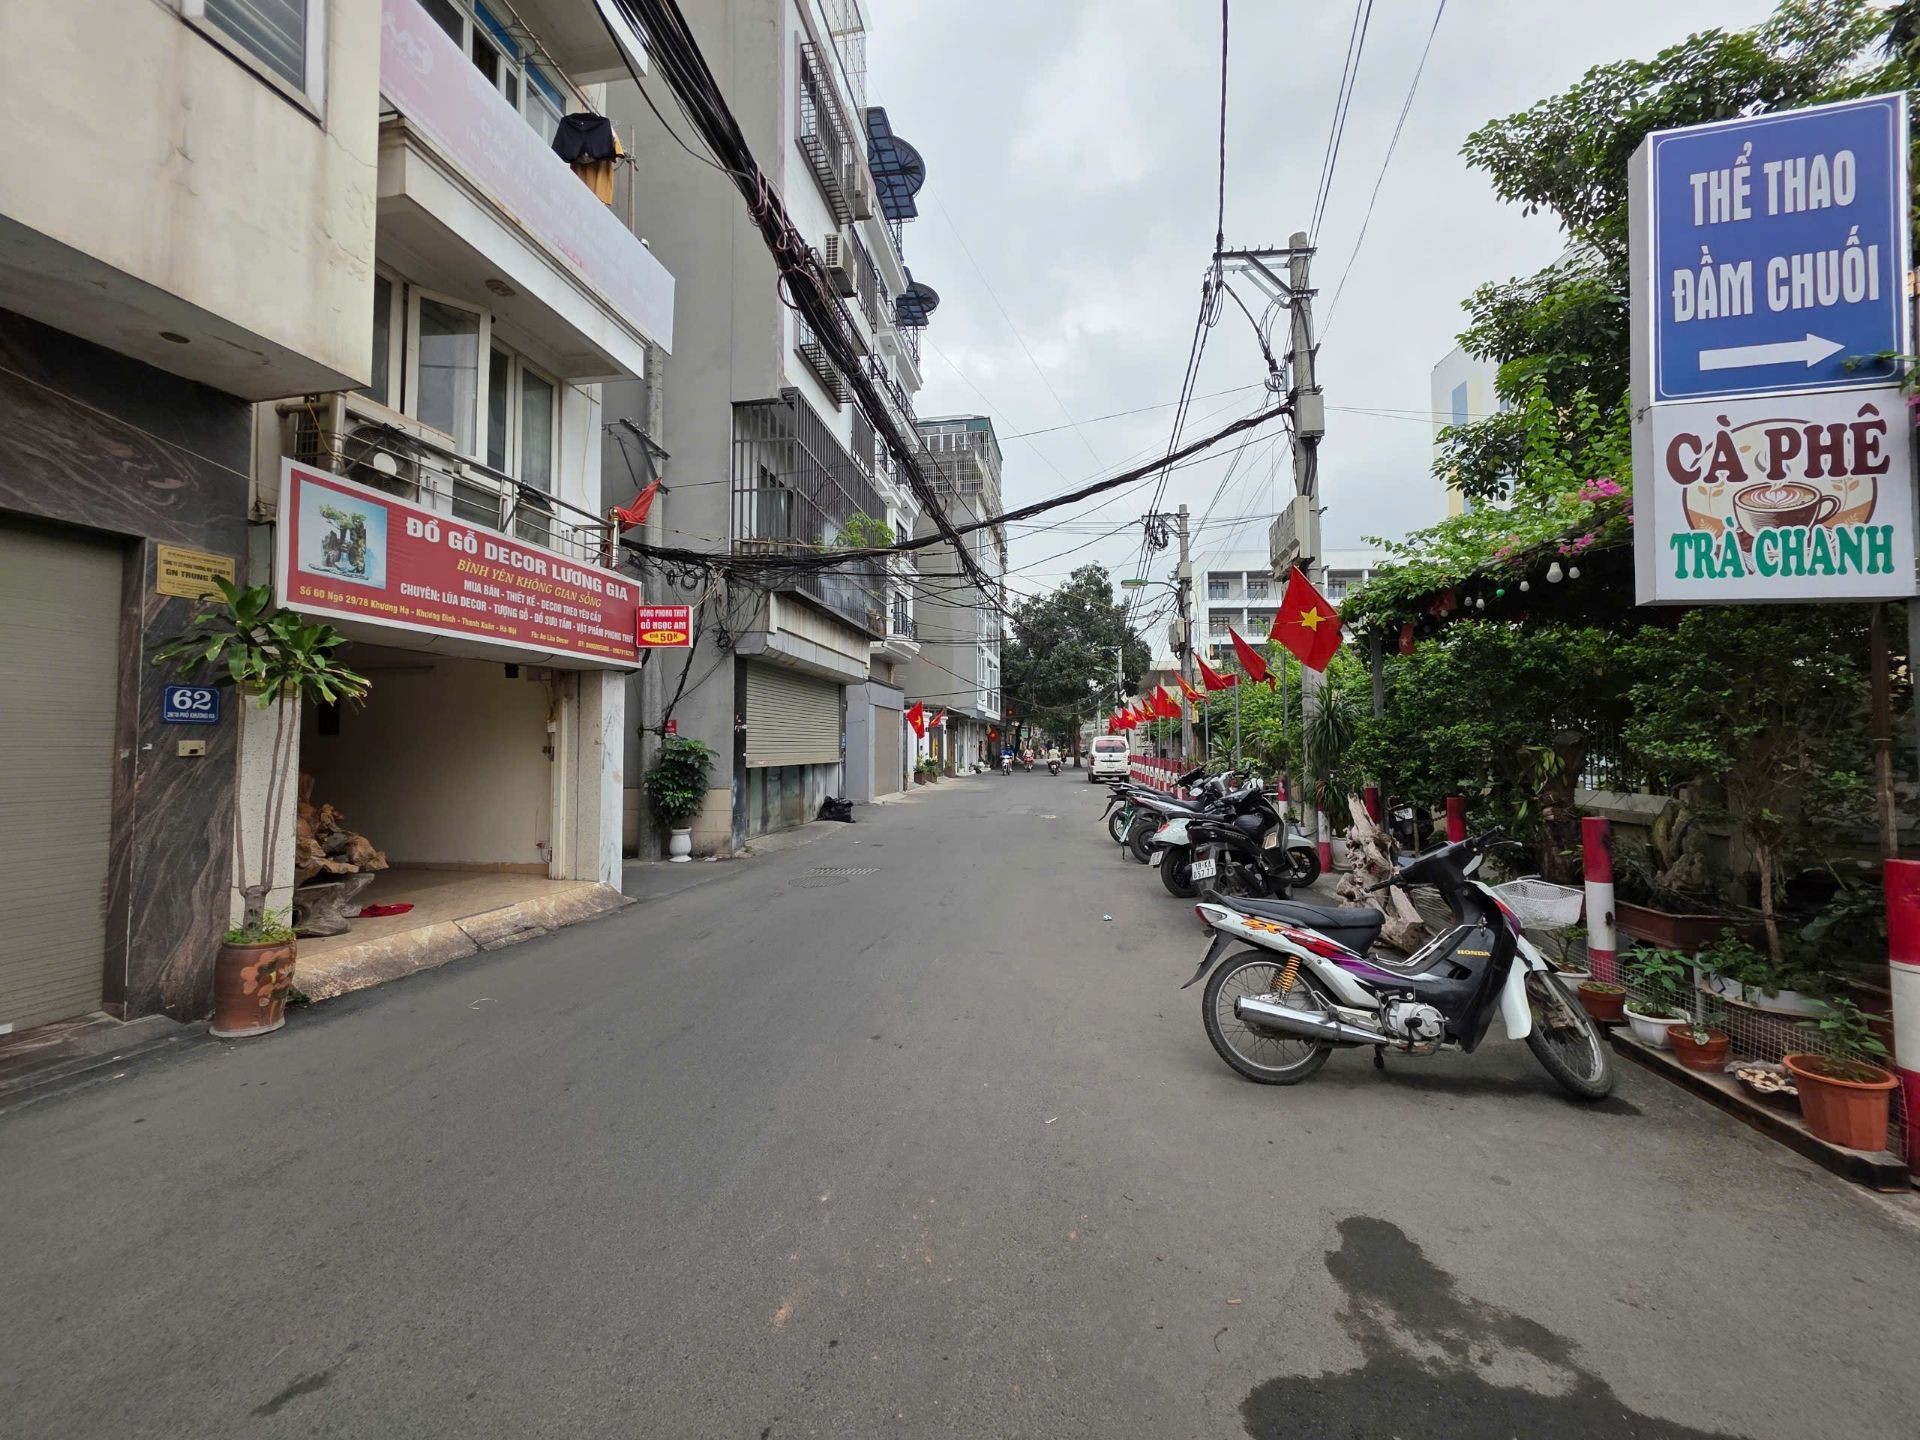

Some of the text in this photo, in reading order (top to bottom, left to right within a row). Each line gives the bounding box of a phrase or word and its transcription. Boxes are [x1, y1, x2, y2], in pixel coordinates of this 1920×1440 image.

[1689, 140, 1857, 227] THỂ THAO
[1671, 224, 1880, 324] ĐẦM CHUỐI
[1665, 402, 1891, 486] CÀ PHÊ
[406, 516, 628, 601] ĐỒ GỖ DECOR LƯƠNG GIA
[1669, 516, 1895, 580] TRÀ CHANH
[299, 585, 311, 596] Số
[313, 588, 325, 599] 60
[327, 591, 344, 603] Ngõ
[345, 594, 369, 607] 29/78
[400, 583, 440, 602] CHUYÊN:
[460, 596, 487, 612] DECOR
[457, 558, 602, 608] BÌNH YÊN KHÔNG GIAN SỐNG
[464, 579, 482, 593] MUA
[483, 584, 500, 598] BÁN
[541, 599, 562, 613] DECOR
[563, 605, 578, 617] THEO
[173, 689, 211, 710] 62
[1456, 949, 1491, 957] HONDA
